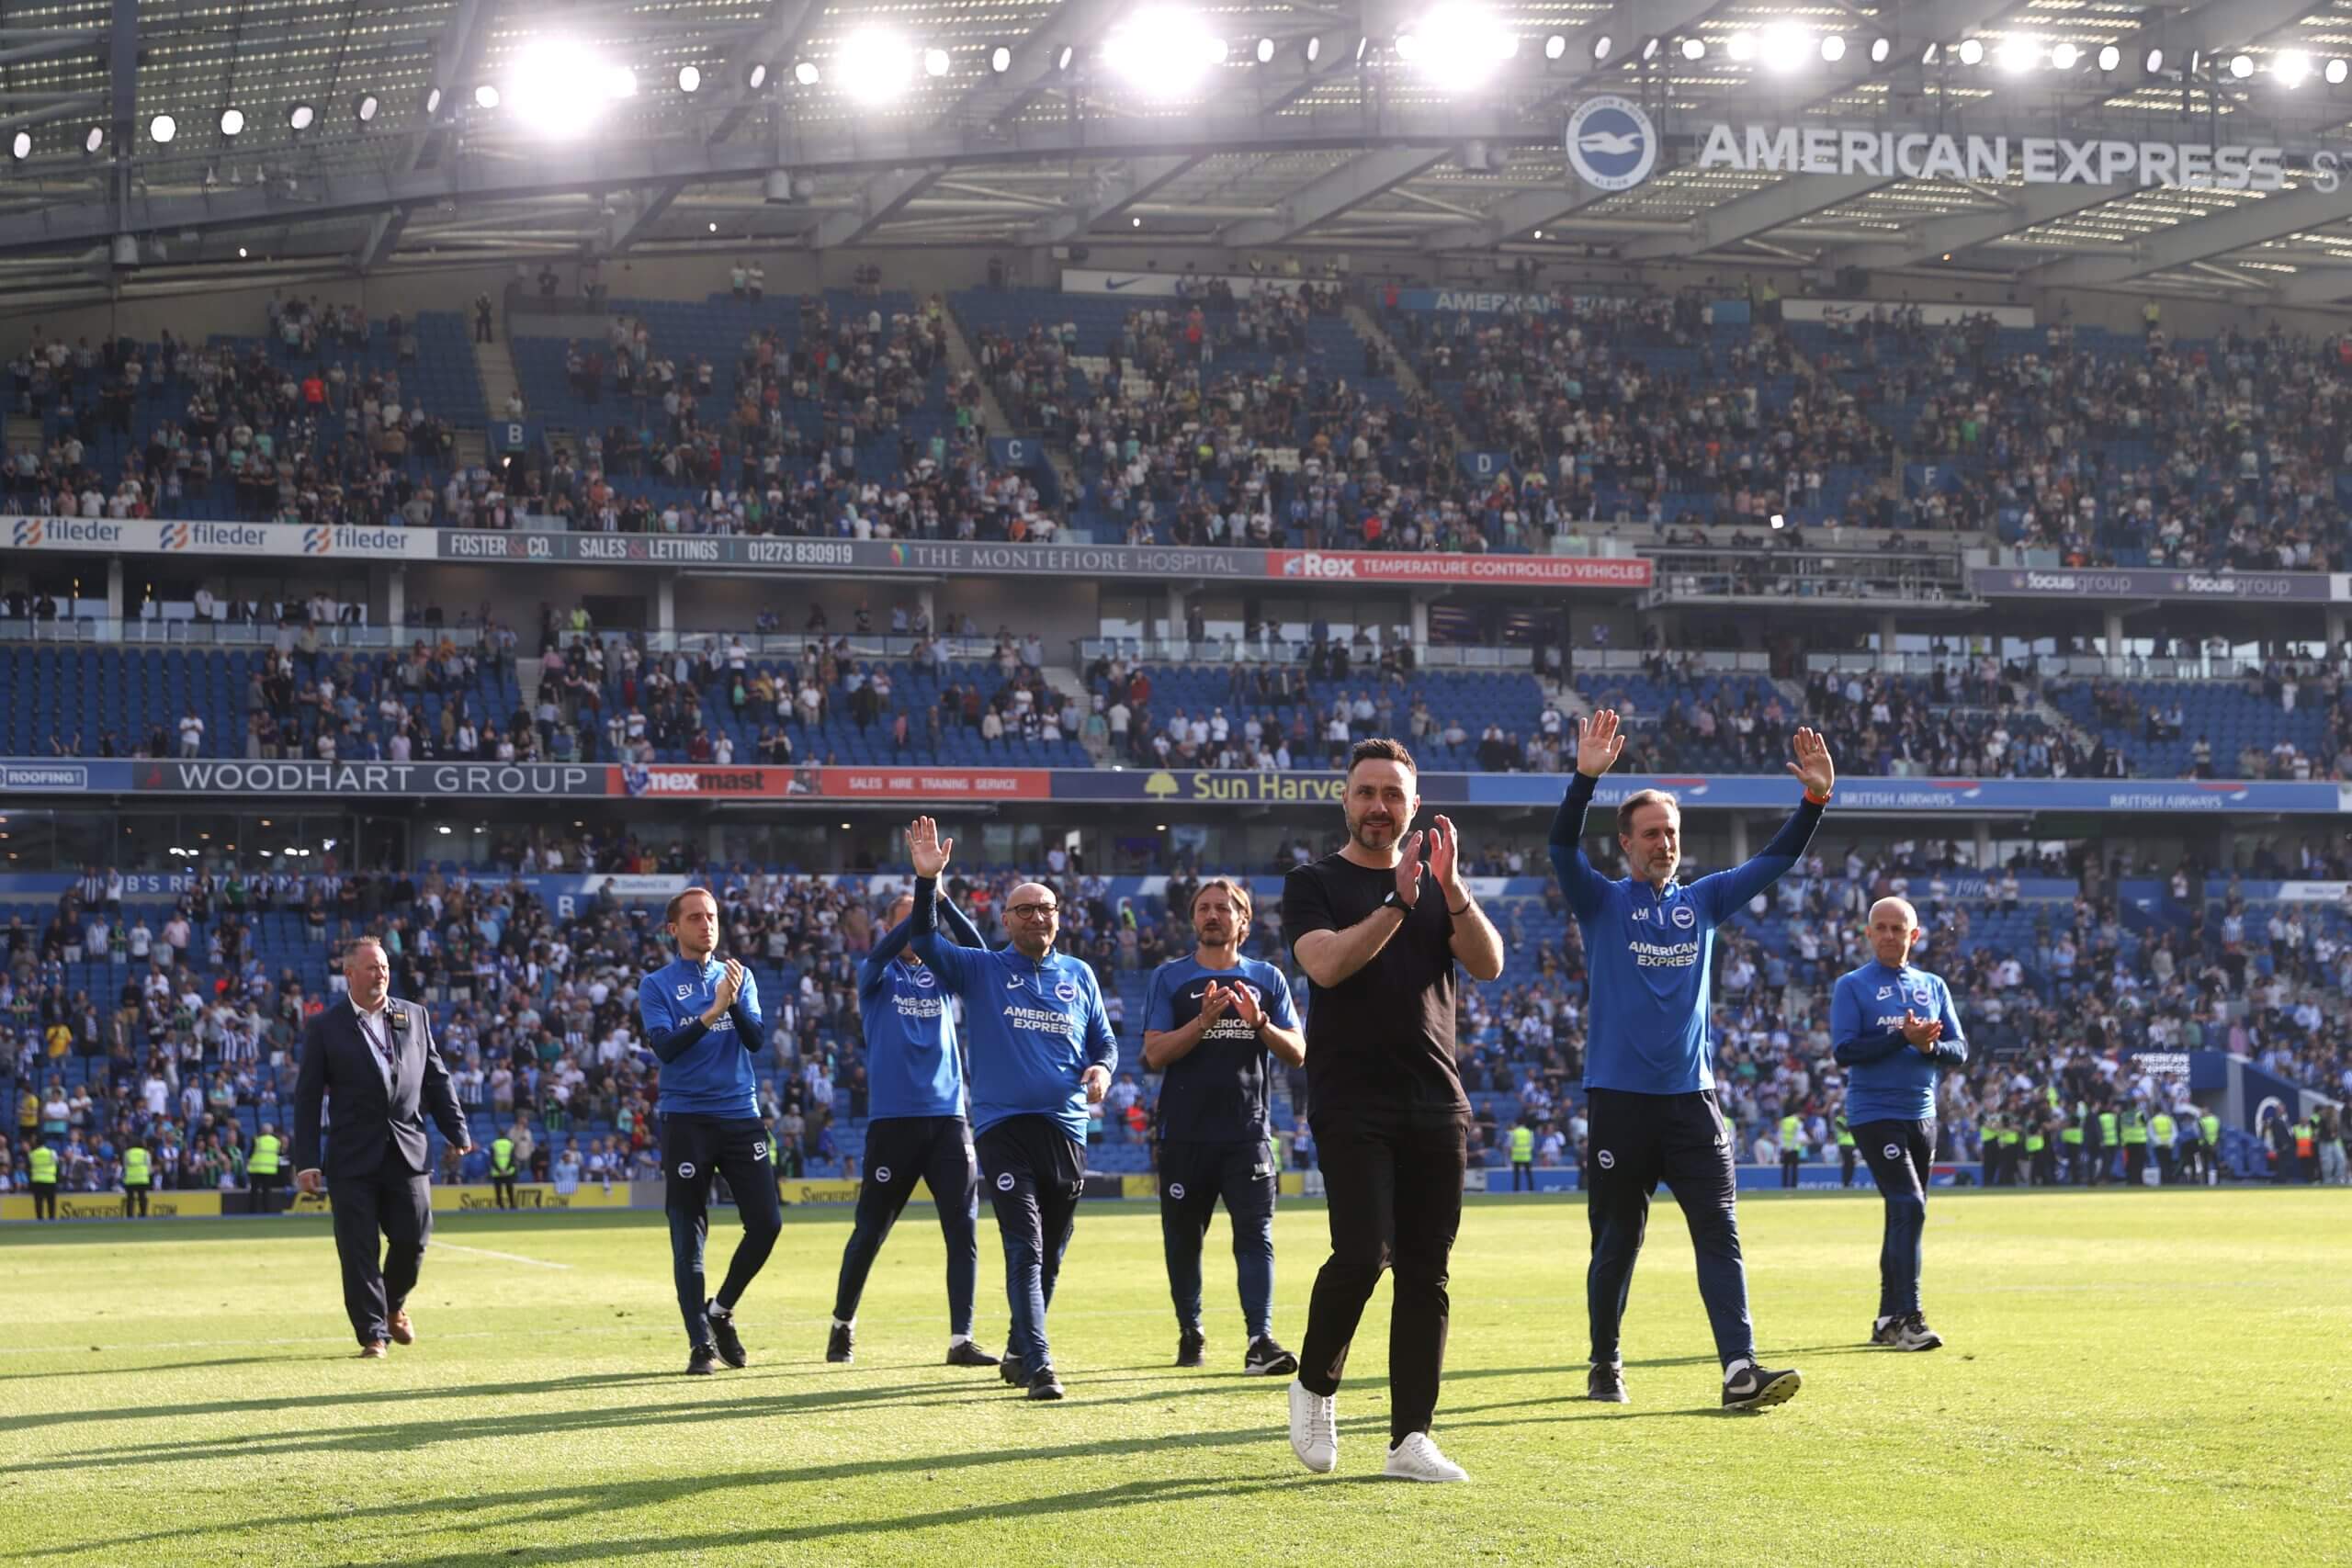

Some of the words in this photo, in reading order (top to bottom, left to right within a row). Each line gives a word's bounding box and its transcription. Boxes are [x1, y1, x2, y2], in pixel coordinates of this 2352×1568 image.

[1699, 124, 2007, 180] AMERICAN
[2022, 138, 2283, 190] EXPRESS
[2312, 152, 2352, 194] S
[508, 423, 523, 444] B
[1008, 440, 1023, 459] C
[1477, 454, 1491, 473] D
[47, 520, 122, 540] fileder
[193, 525, 266, 547] fileder
[335, 529, 408, 550] fileder
[451, 538, 507, 556] FOSTER
[526, 540, 552, 558] CO.
[580, 540, 626, 558] SALES
[649, 542, 718, 561] LETTINGS
[748, 544, 794, 562] 01273
[796, 545, 852, 564] 830919
[913, 547, 961, 566] THE
[971, 548, 1128, 570] MONTEFIORE
[1137, 553, 1239, 572] HOSPITAL
[1305, 554, 1355, 577] Rex
[1363, 558, 1468, 576] TEMPERATURE
[1472, 560, 1570, 578] CONTROLLED
[1574, 563, 1645, 581] VEHICLES
[179, 765, 414, 791] WOODHART
[434, 767, 586, 794] GROUP
[849, 779, 882, 792] SALES
[889, 779, 912, 792] HIRE
[1193, 774, 1249, 799] Sun
[1259, 775, 1346, 800] Harve
[1840, 792, 1894, 805] BRITISH
[1896, 793, 1954, 807] AIRWAYS
[2109, 795, 2165, 808] BRITISH
[2166, 796, 2222, 809] AIRWAYS
[558, 896, 574, 918] B
[1629, 941, 1698, 956] AMERICAN
[677, 984, 693, 995] EV
[1003, 1006, 1074, 1025] AMERICAN
[1013, 1018, 1074, 1038] EXPRESS
